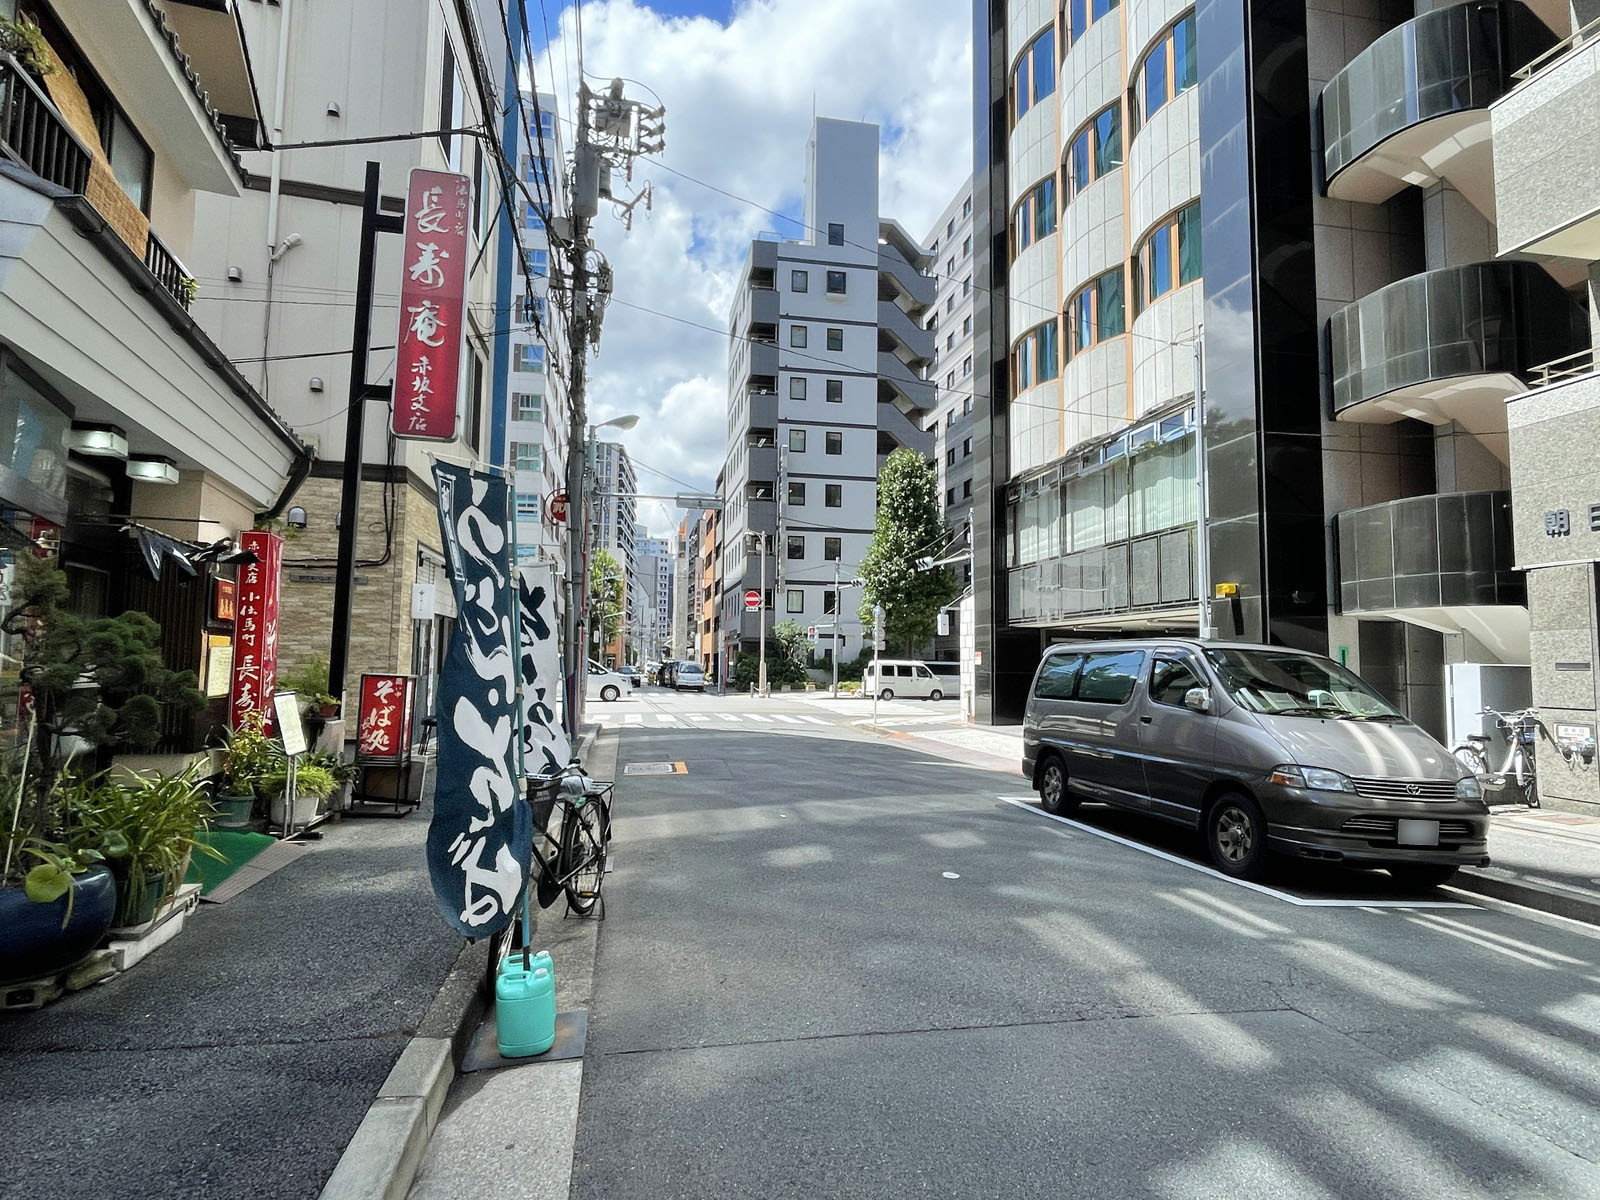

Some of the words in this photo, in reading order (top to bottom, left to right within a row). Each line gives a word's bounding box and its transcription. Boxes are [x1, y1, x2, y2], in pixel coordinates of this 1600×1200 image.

[245, 540, 260, 584] 赤支店
[366, 679, 395, 752] そば処
